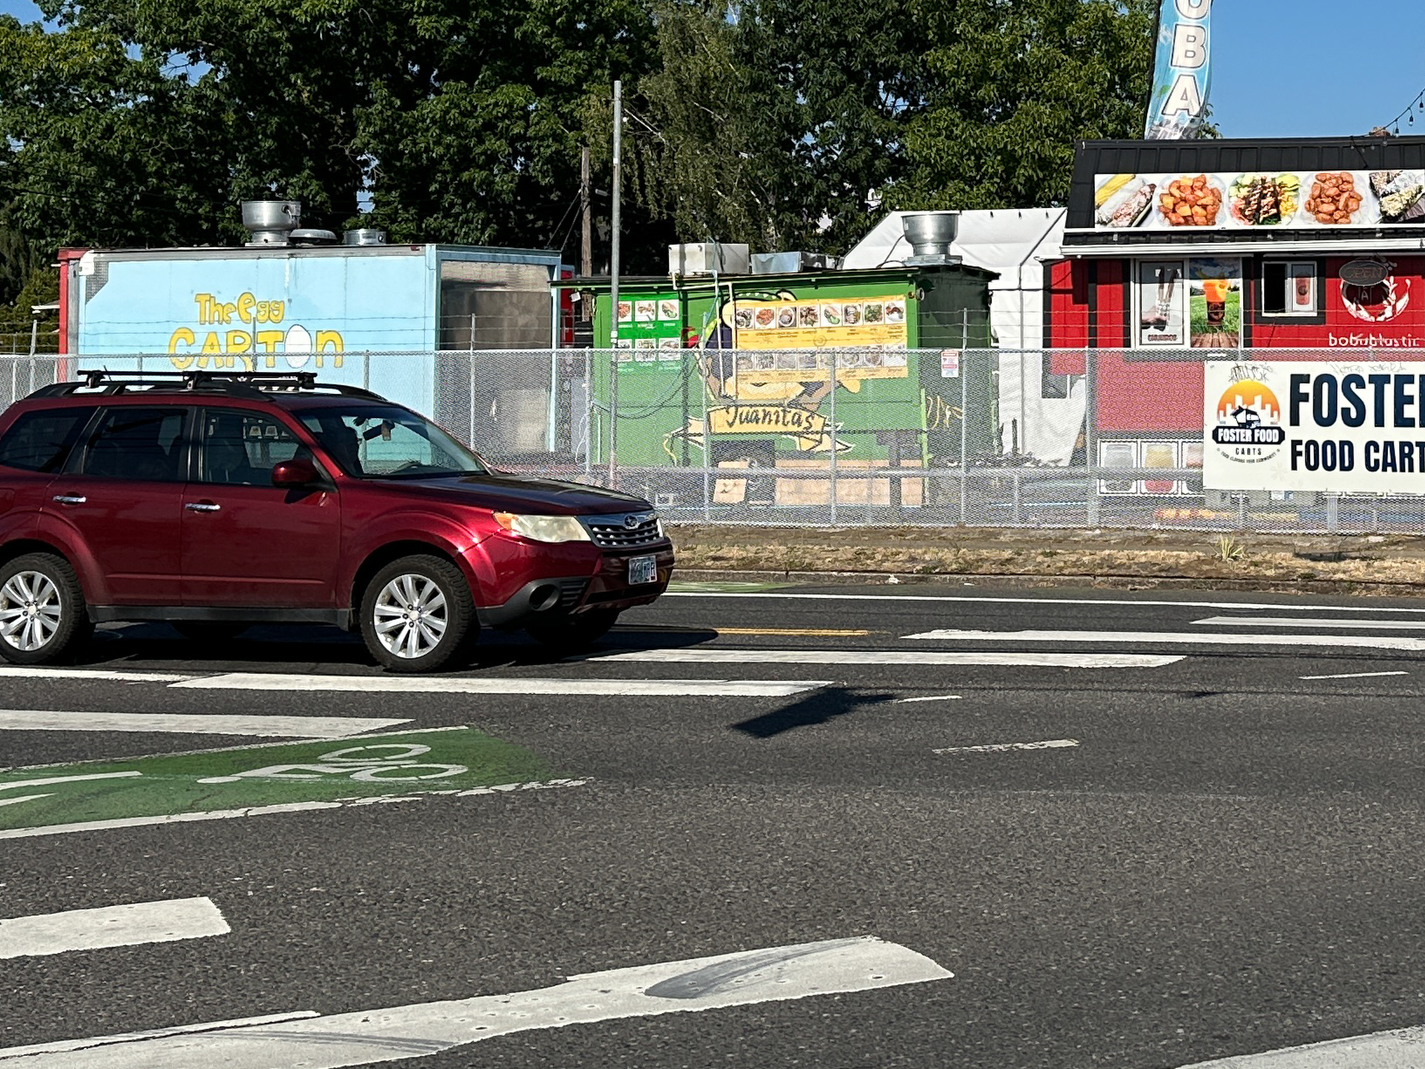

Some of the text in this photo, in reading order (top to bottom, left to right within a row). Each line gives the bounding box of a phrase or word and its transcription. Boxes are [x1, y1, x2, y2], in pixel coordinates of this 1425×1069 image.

[1344, 267, 1384, 279] OPEN
[194, 293, 237, 326] The
[725, 406, 815, 431] Juanitas
[1217, 428, 1279, 443] FOSTER FOOD
[1235, 447, 1262, 456] CARTS
[1290, 439, 1355, 472] FOOD
